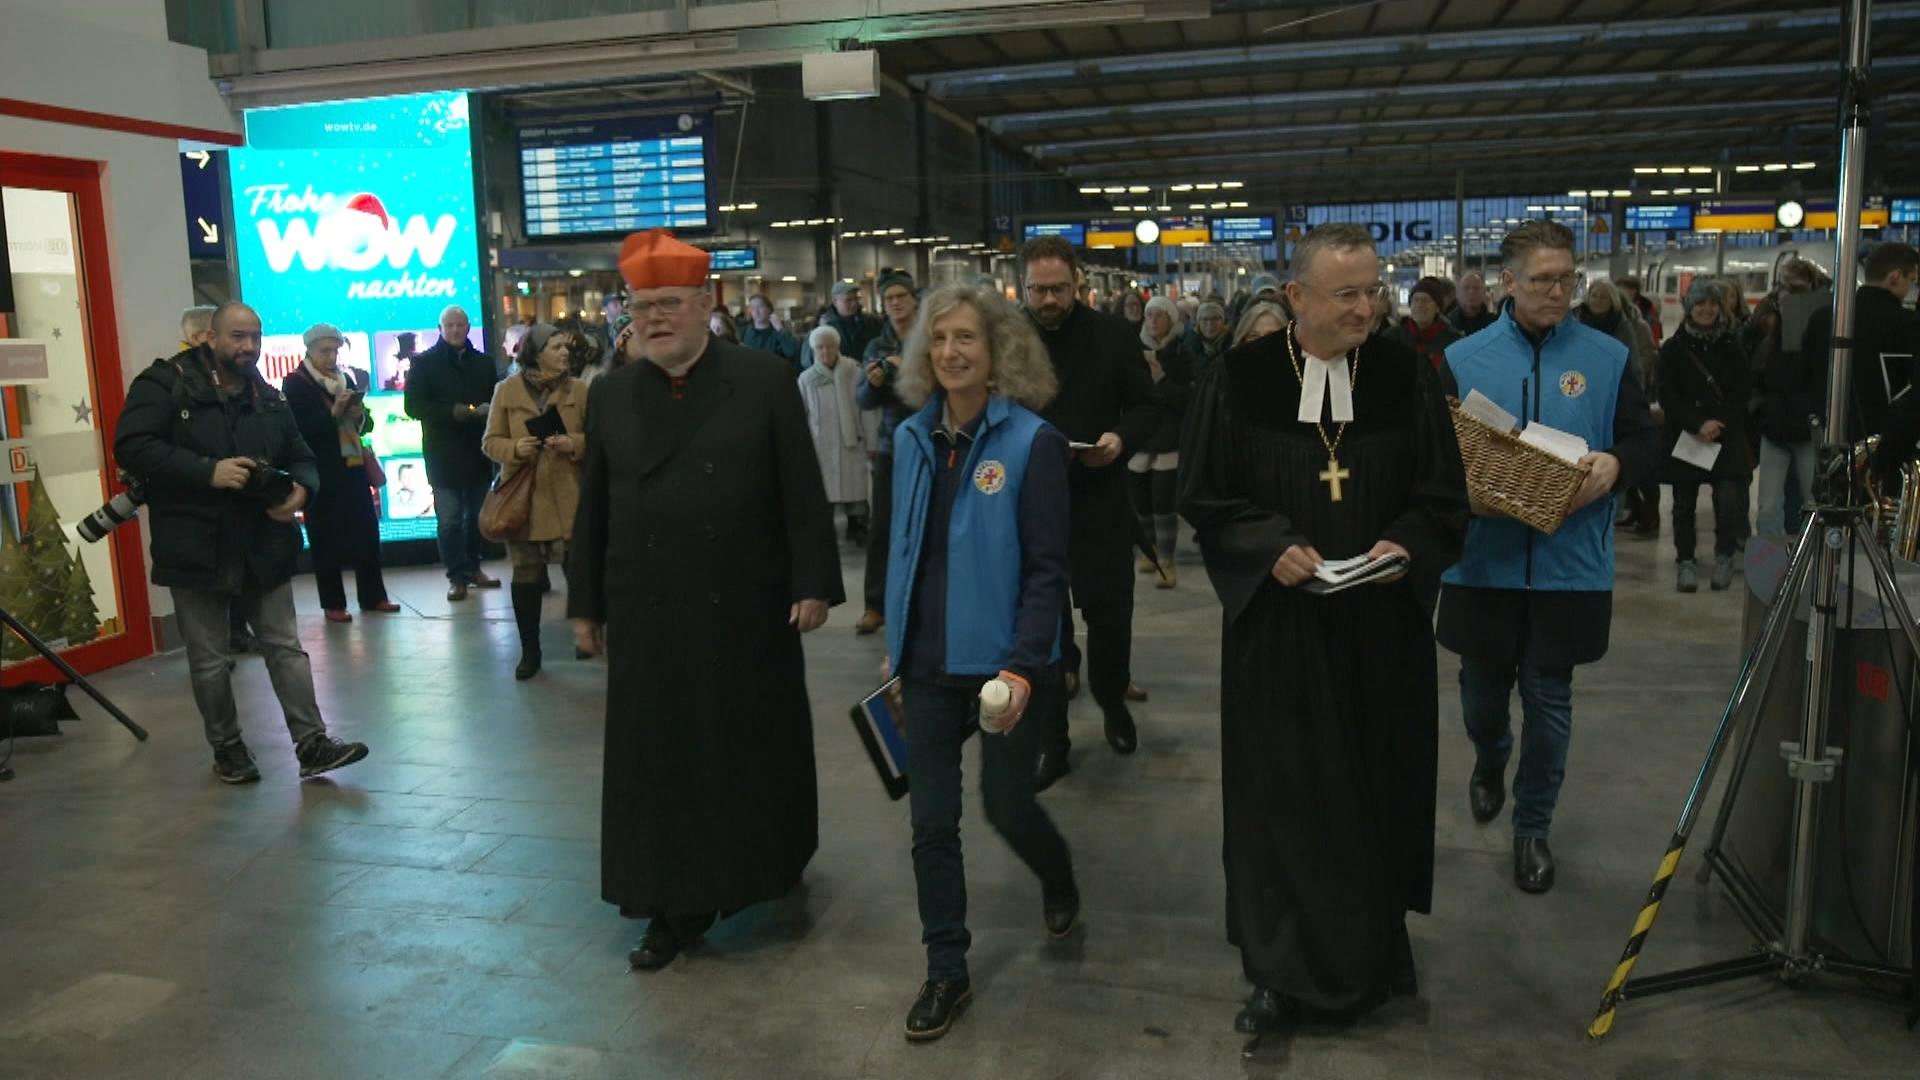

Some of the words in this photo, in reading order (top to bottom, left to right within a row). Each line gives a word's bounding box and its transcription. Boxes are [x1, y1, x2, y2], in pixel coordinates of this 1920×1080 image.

[324, 122, 377, 133] wowtv.de
[244, 184, 336, 216] Frohe
[994, 216, 1009, 229] 12
[1291, 205, 1306, 220] 13
[257, 211, 457, 273] WOW
[348, 270, 457, 299] nachten
